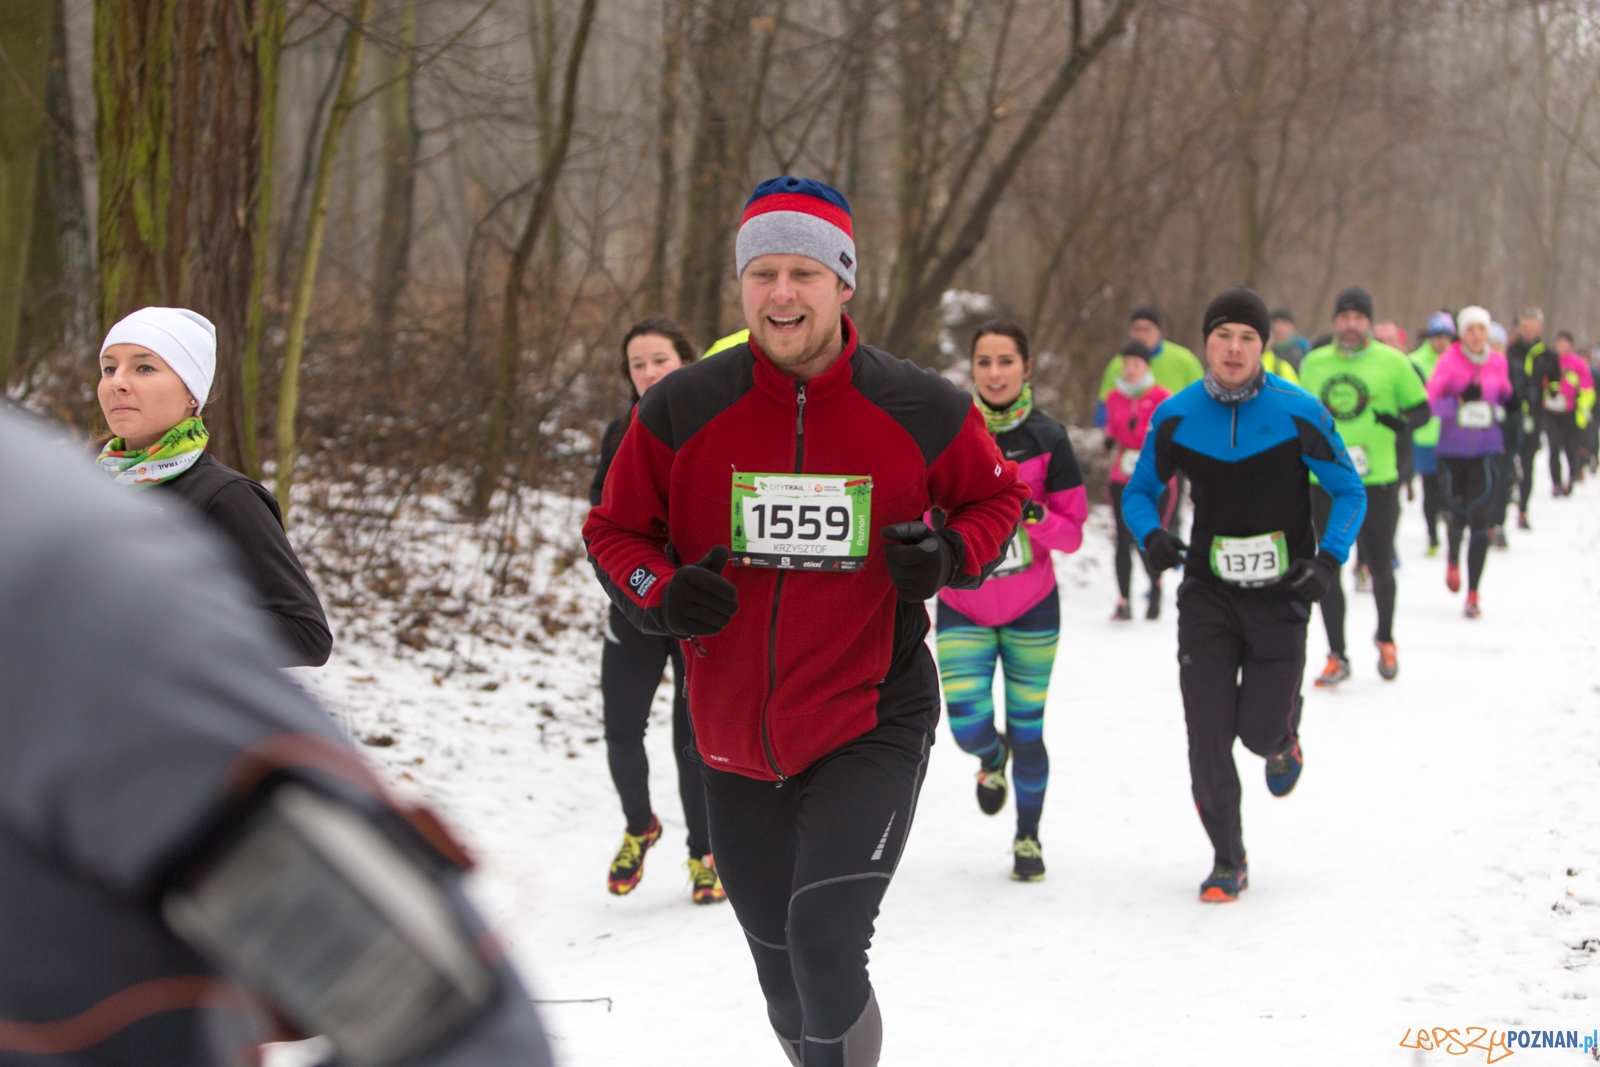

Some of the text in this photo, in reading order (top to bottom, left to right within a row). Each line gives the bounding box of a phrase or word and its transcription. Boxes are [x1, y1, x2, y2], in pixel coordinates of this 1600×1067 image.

[752, 504, 850, 541] 1559
[856, 514, 866, 546] Poznań
[773, 543, 828, 554] KRZYSZTOF
[1223, 550, 1276, 572] 1373
